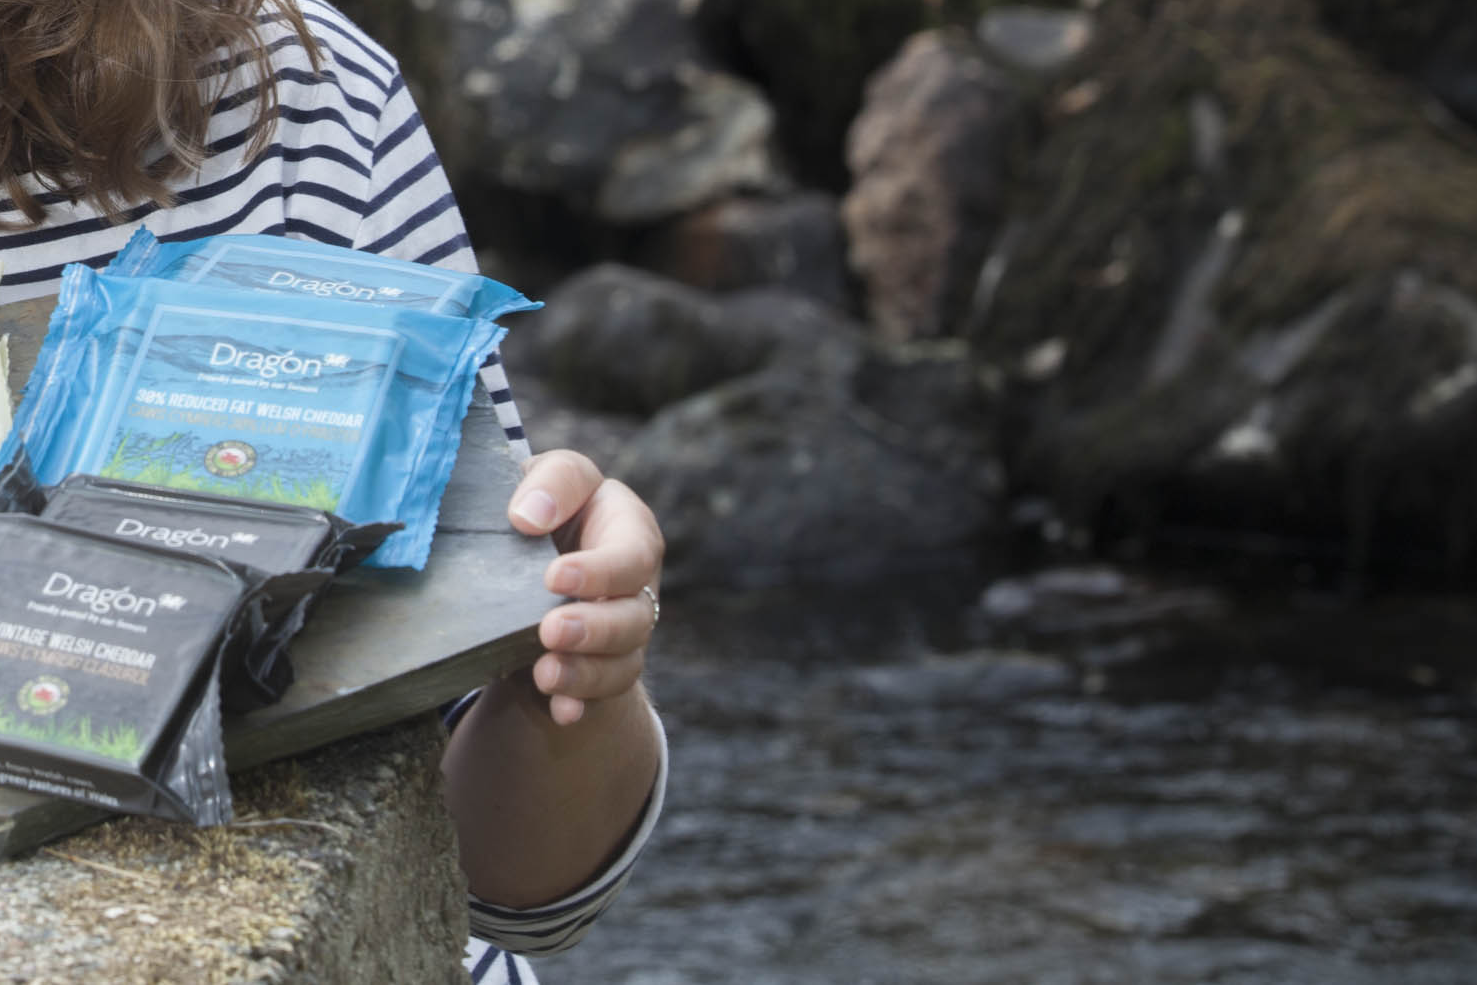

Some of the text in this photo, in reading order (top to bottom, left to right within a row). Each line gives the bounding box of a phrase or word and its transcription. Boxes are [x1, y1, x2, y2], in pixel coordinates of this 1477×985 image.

[211, 341, 322, 379] Dragon
[167, 394, 228, 414] REDUCED
[229, 399, 255, 416] FAT
[256, 401, 303, 422] WELSH
[303, 408, 364, 428] CHEDDAR
[116, 517, 230, 550] Dragon
[43, 570, 157, 618] Dragon
[49, 631, 95, 656] WELSH
[94, 643, 157, 670] CHEDDAR
